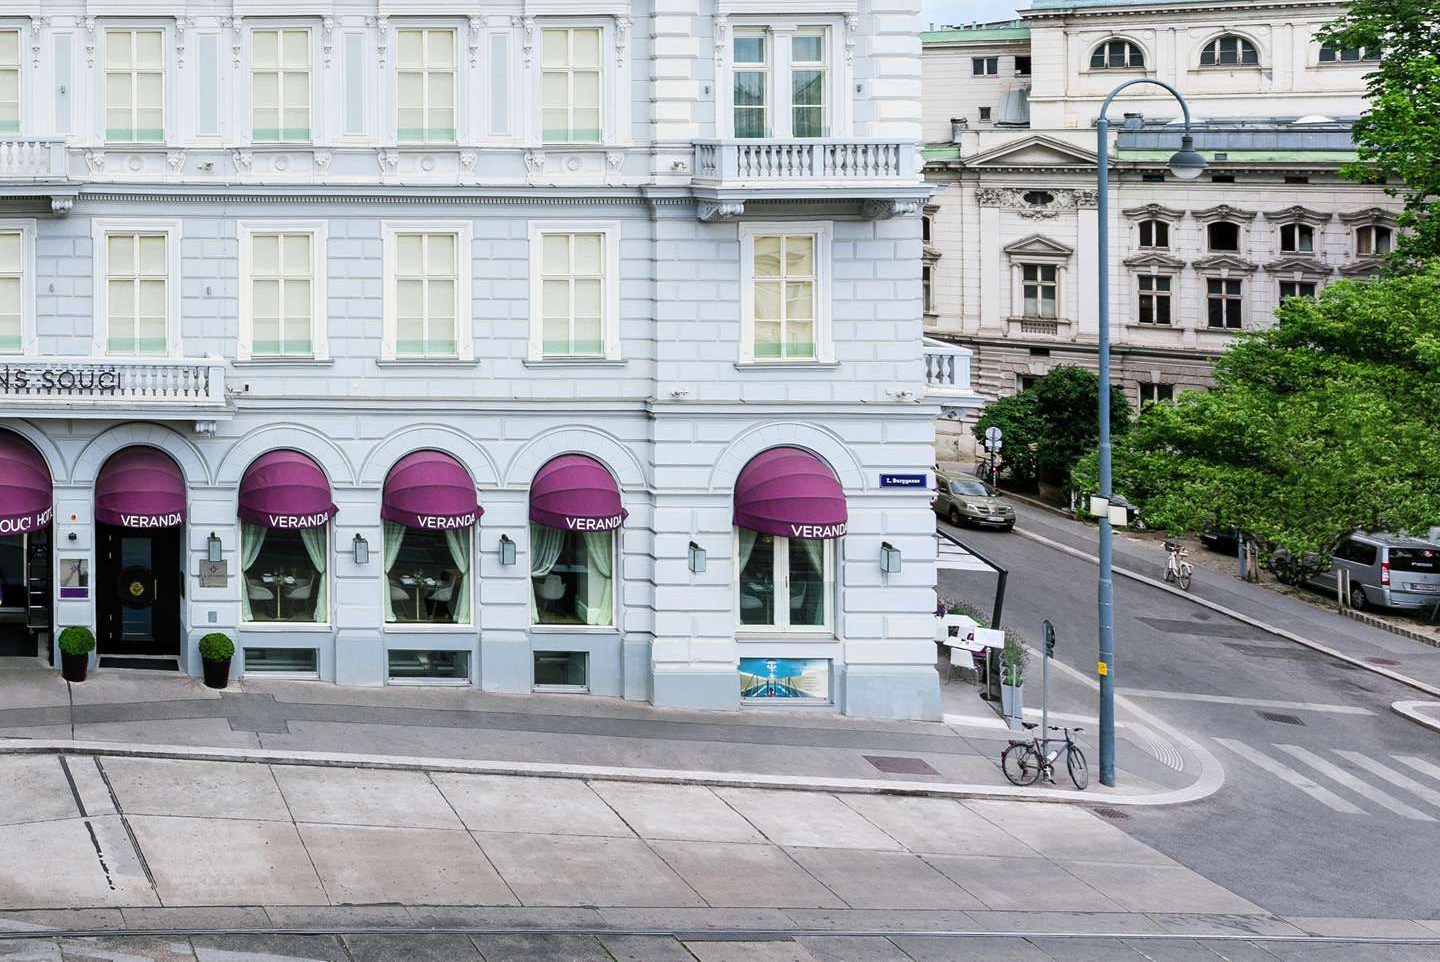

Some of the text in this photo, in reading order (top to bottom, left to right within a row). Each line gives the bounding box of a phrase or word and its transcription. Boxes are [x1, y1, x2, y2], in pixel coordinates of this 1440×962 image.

[42, 371, 121, 389] SOUCI
[120, 512, 182, 527] VERANDA
[268, 511, 328, 528] VERANDA
